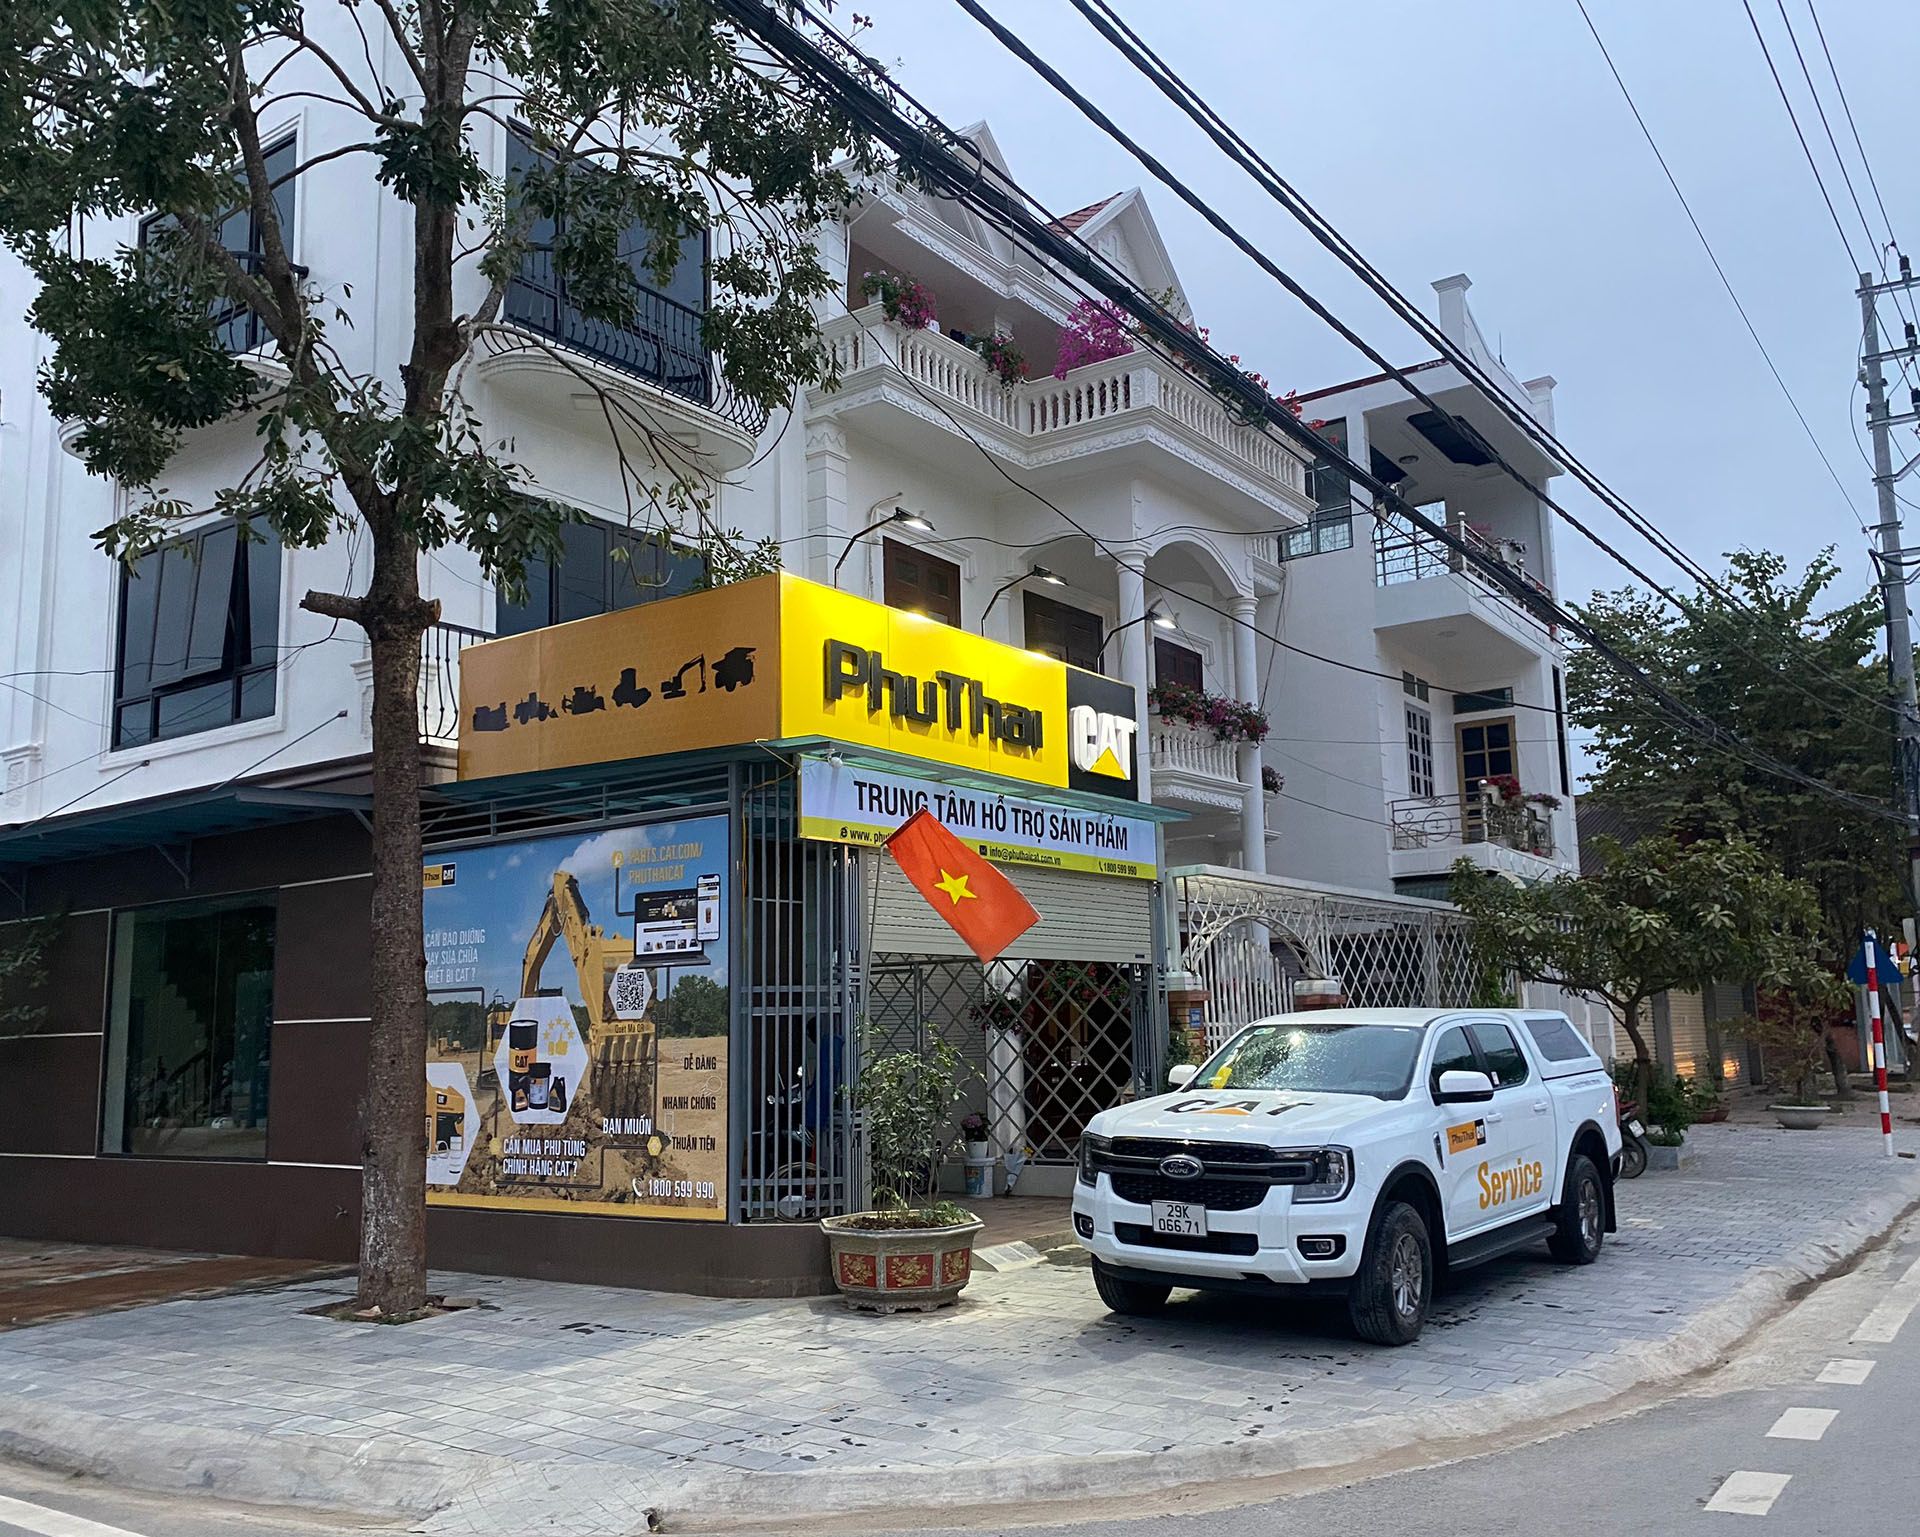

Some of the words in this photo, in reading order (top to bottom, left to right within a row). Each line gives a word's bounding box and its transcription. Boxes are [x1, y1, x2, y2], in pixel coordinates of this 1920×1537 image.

[823, 638, 1043, 749] PhuThai
[853, 780, 929, 817] TRUNG
[933, 790, 976, 827] TÂM
[982, 795, 1007, 832] HỖ
[1011, 807, 1045, 843] TRỢ
[1050, 808, 1081, 844] SẢN
[1086, 815, 1128, 851] PHẨM
[989, 845, 1061, 866] info@phuthaicat.com.vn
[443, 869, 456, 880] CAT
[629, 864, 685, 885] PHUTHAICAT
[1104, 862, 1117, 873] 1800
[1117, 864, 1127, 875] 599
[1127, 865, 1137, 876] 990
[515, 1055, 529, 1068] CAT
[696, 1055, 716, 1070] DÀNG
[662, 1096, 688, 1110] NHANH
[691, 1094, 716, 1110] CHÓNG
[1164, 1099, 1315, 1116] CAT
[603, 1117, 621, 1138] BẠN
[624, 1113, 652, 1135] MUỐN
[523, 1139, 541, 1155] MUA
[544, 1139, 561, 1159] PHỤ
[563, 1137, 586, 1157] TÙNG
[672, 1135, 697, 1153] THUẬN
[699, 1135, 716, 1153] TIỆN
[503, 1156, 527, 1174] CHÍNH
[530, 1157, 552, 1175] HÃNG
[1168, 1162, 1189, 1175] Ford
[648, 1179, 672, 1197] 1800
[675, 1180, 693, 1198] 599
[696, 1181, 714, 1199] 990
[1477, 1157, 1543, 1210] Service
[1167, 1204, 1190, 1219] 29K
[1158, 1218, 1200, 1234] 066.71
